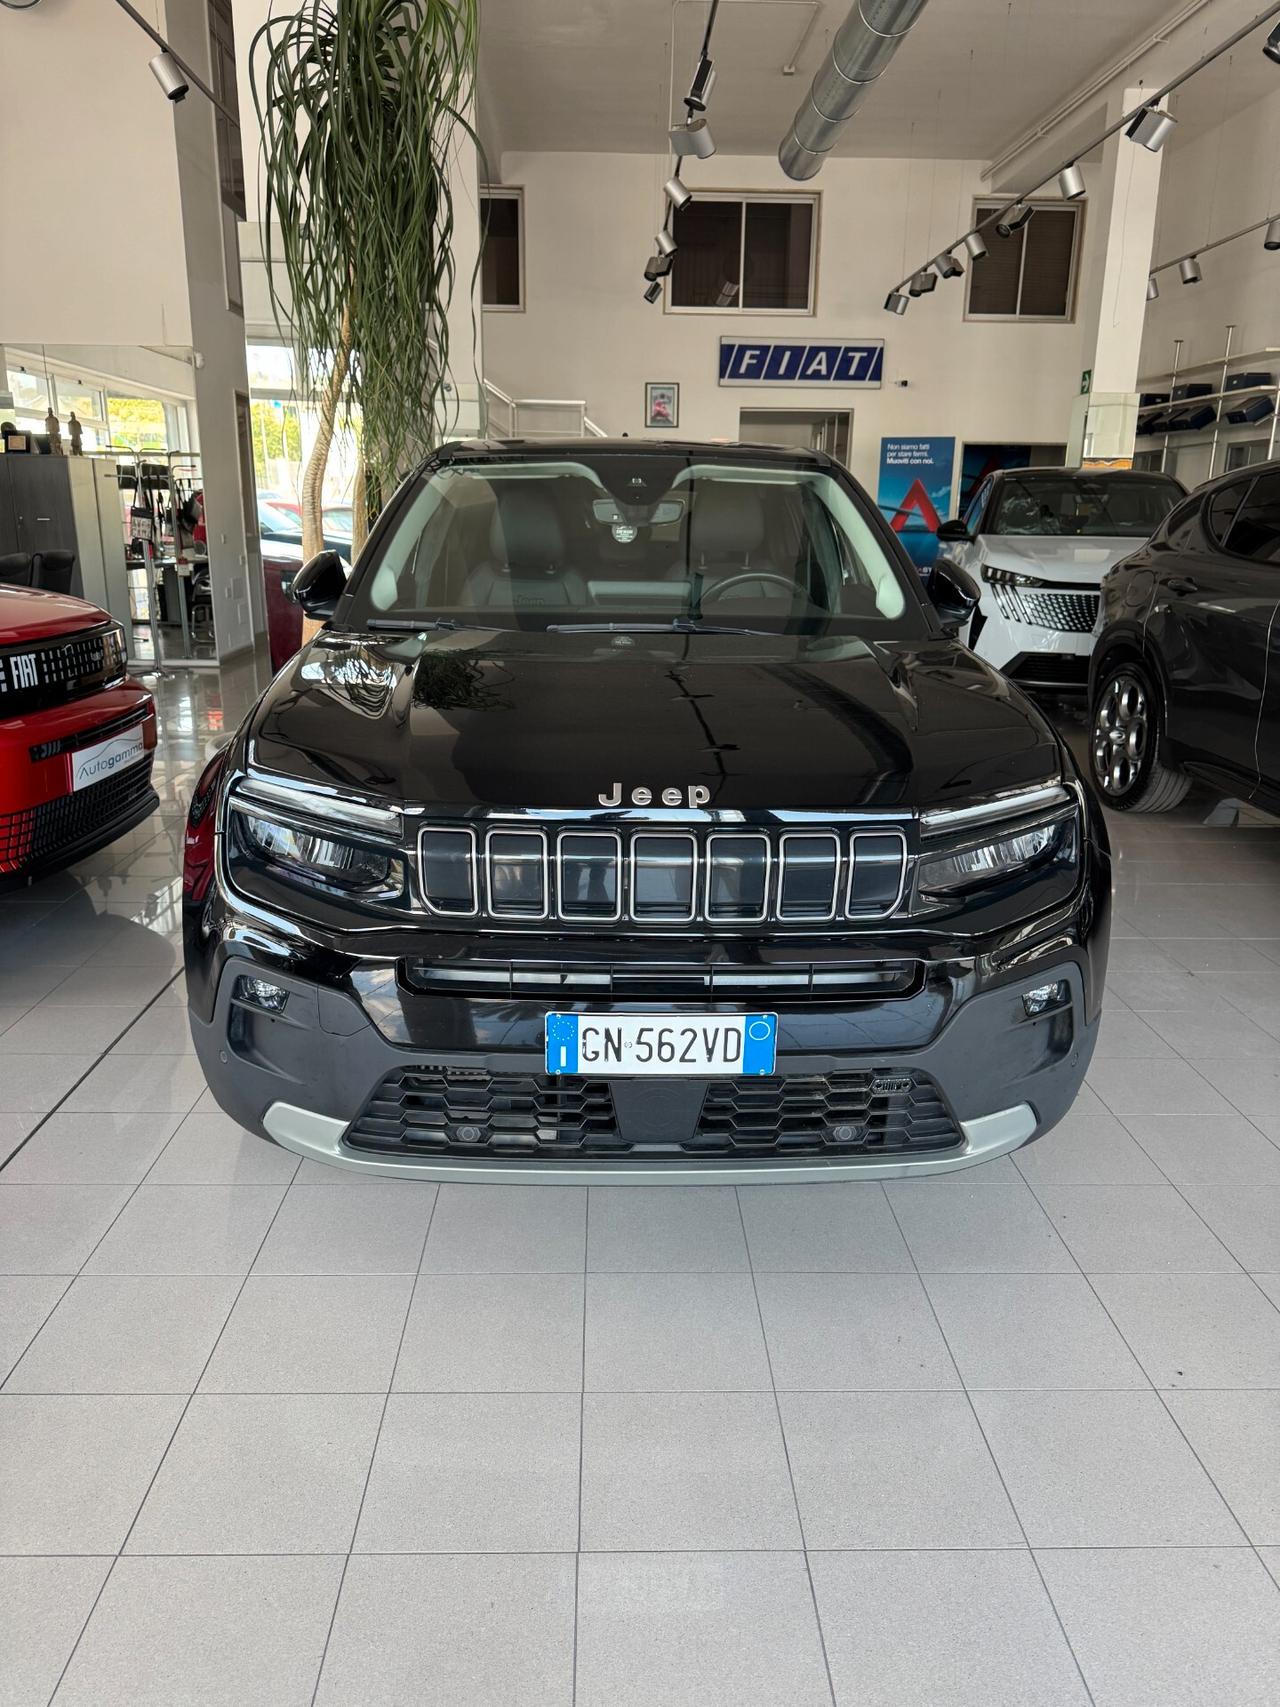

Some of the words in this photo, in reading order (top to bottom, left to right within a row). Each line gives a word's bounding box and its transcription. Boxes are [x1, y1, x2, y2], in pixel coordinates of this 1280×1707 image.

[738, 350, 868, 376] FIAT
[887, 451, 897, 459] per
[9, 653, 39, 690] FIAT
[79, 742, 144, 780] Autogamma
[598, 782, 711, 808] Jeep
